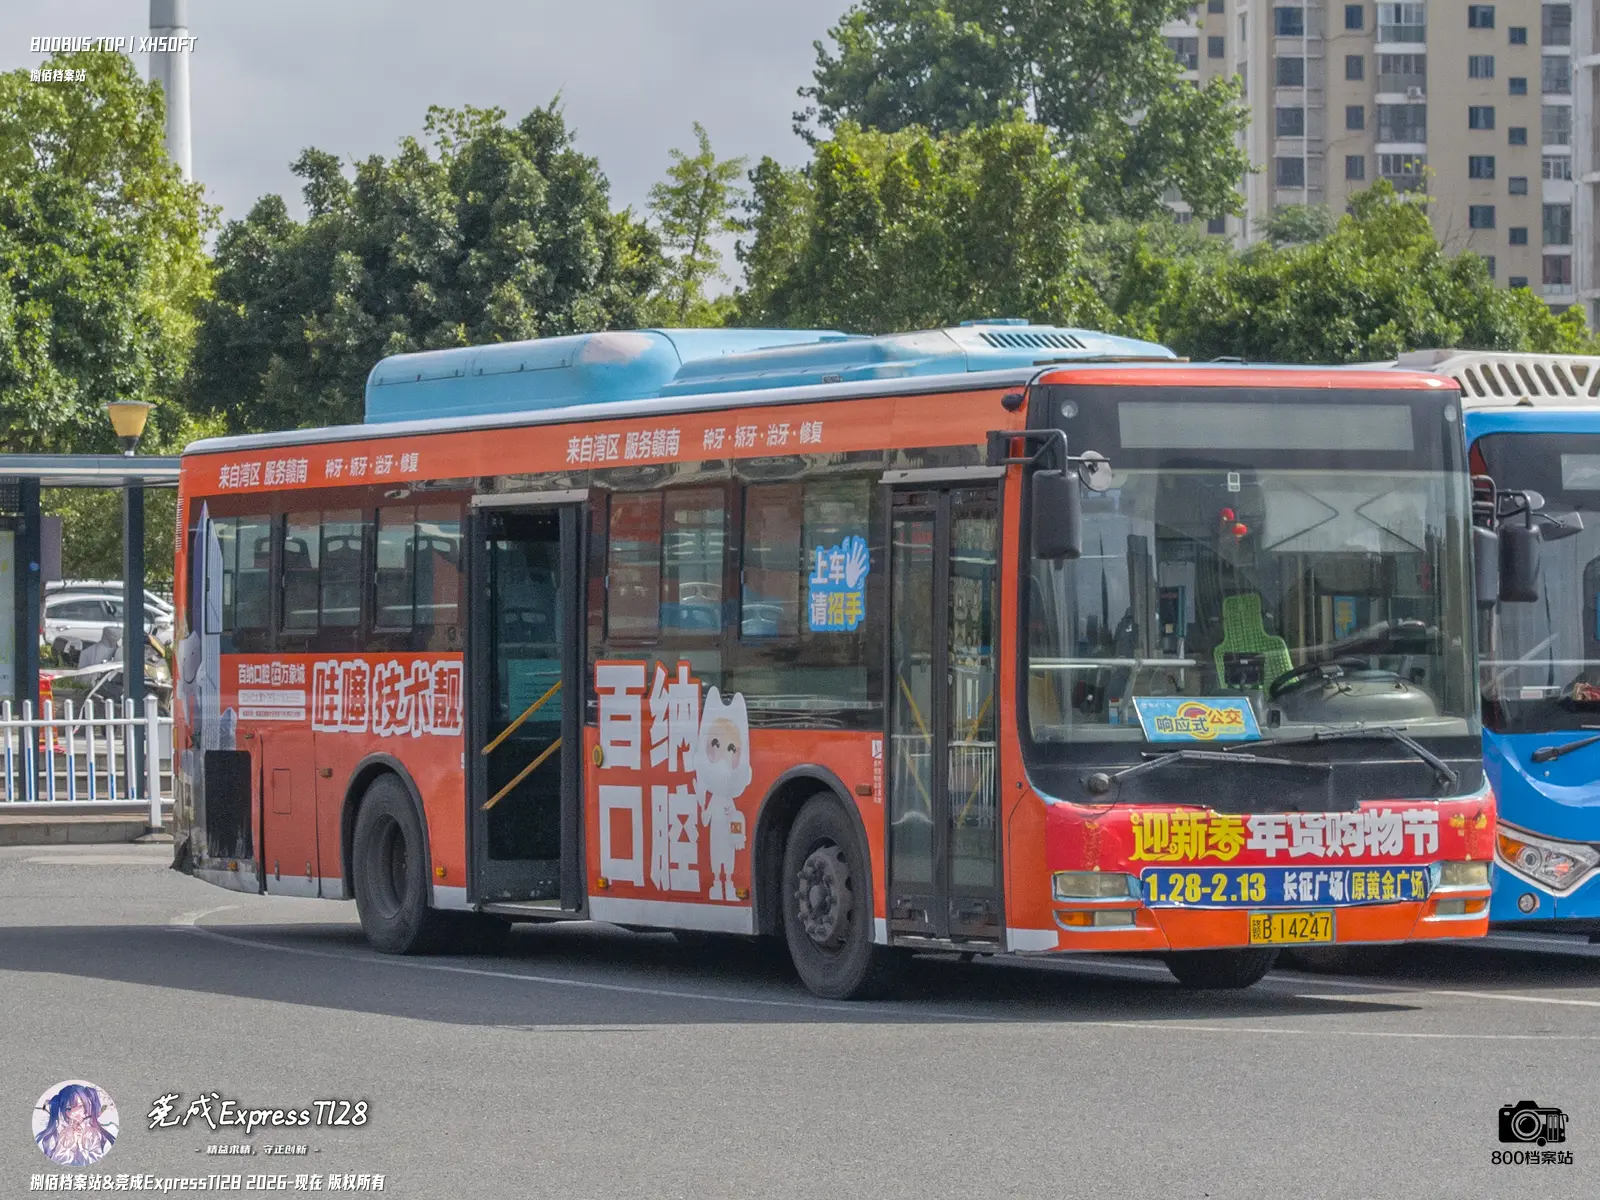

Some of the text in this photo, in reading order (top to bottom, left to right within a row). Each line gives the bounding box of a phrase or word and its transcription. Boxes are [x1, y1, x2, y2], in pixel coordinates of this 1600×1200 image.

[564, 428, 681, 464] 来自湾区 服务赣南
[218, 457, 308, 489] 来自湾区 服务赣南
[811, 551, 845, 585] 上车
[811, 591, 862, 625] 请招手
[596, 664, 700, 773] 百纳
[598, 784, 701, 893] 口腔
[1145, 872, 1266, 903] 1.28-2.13
